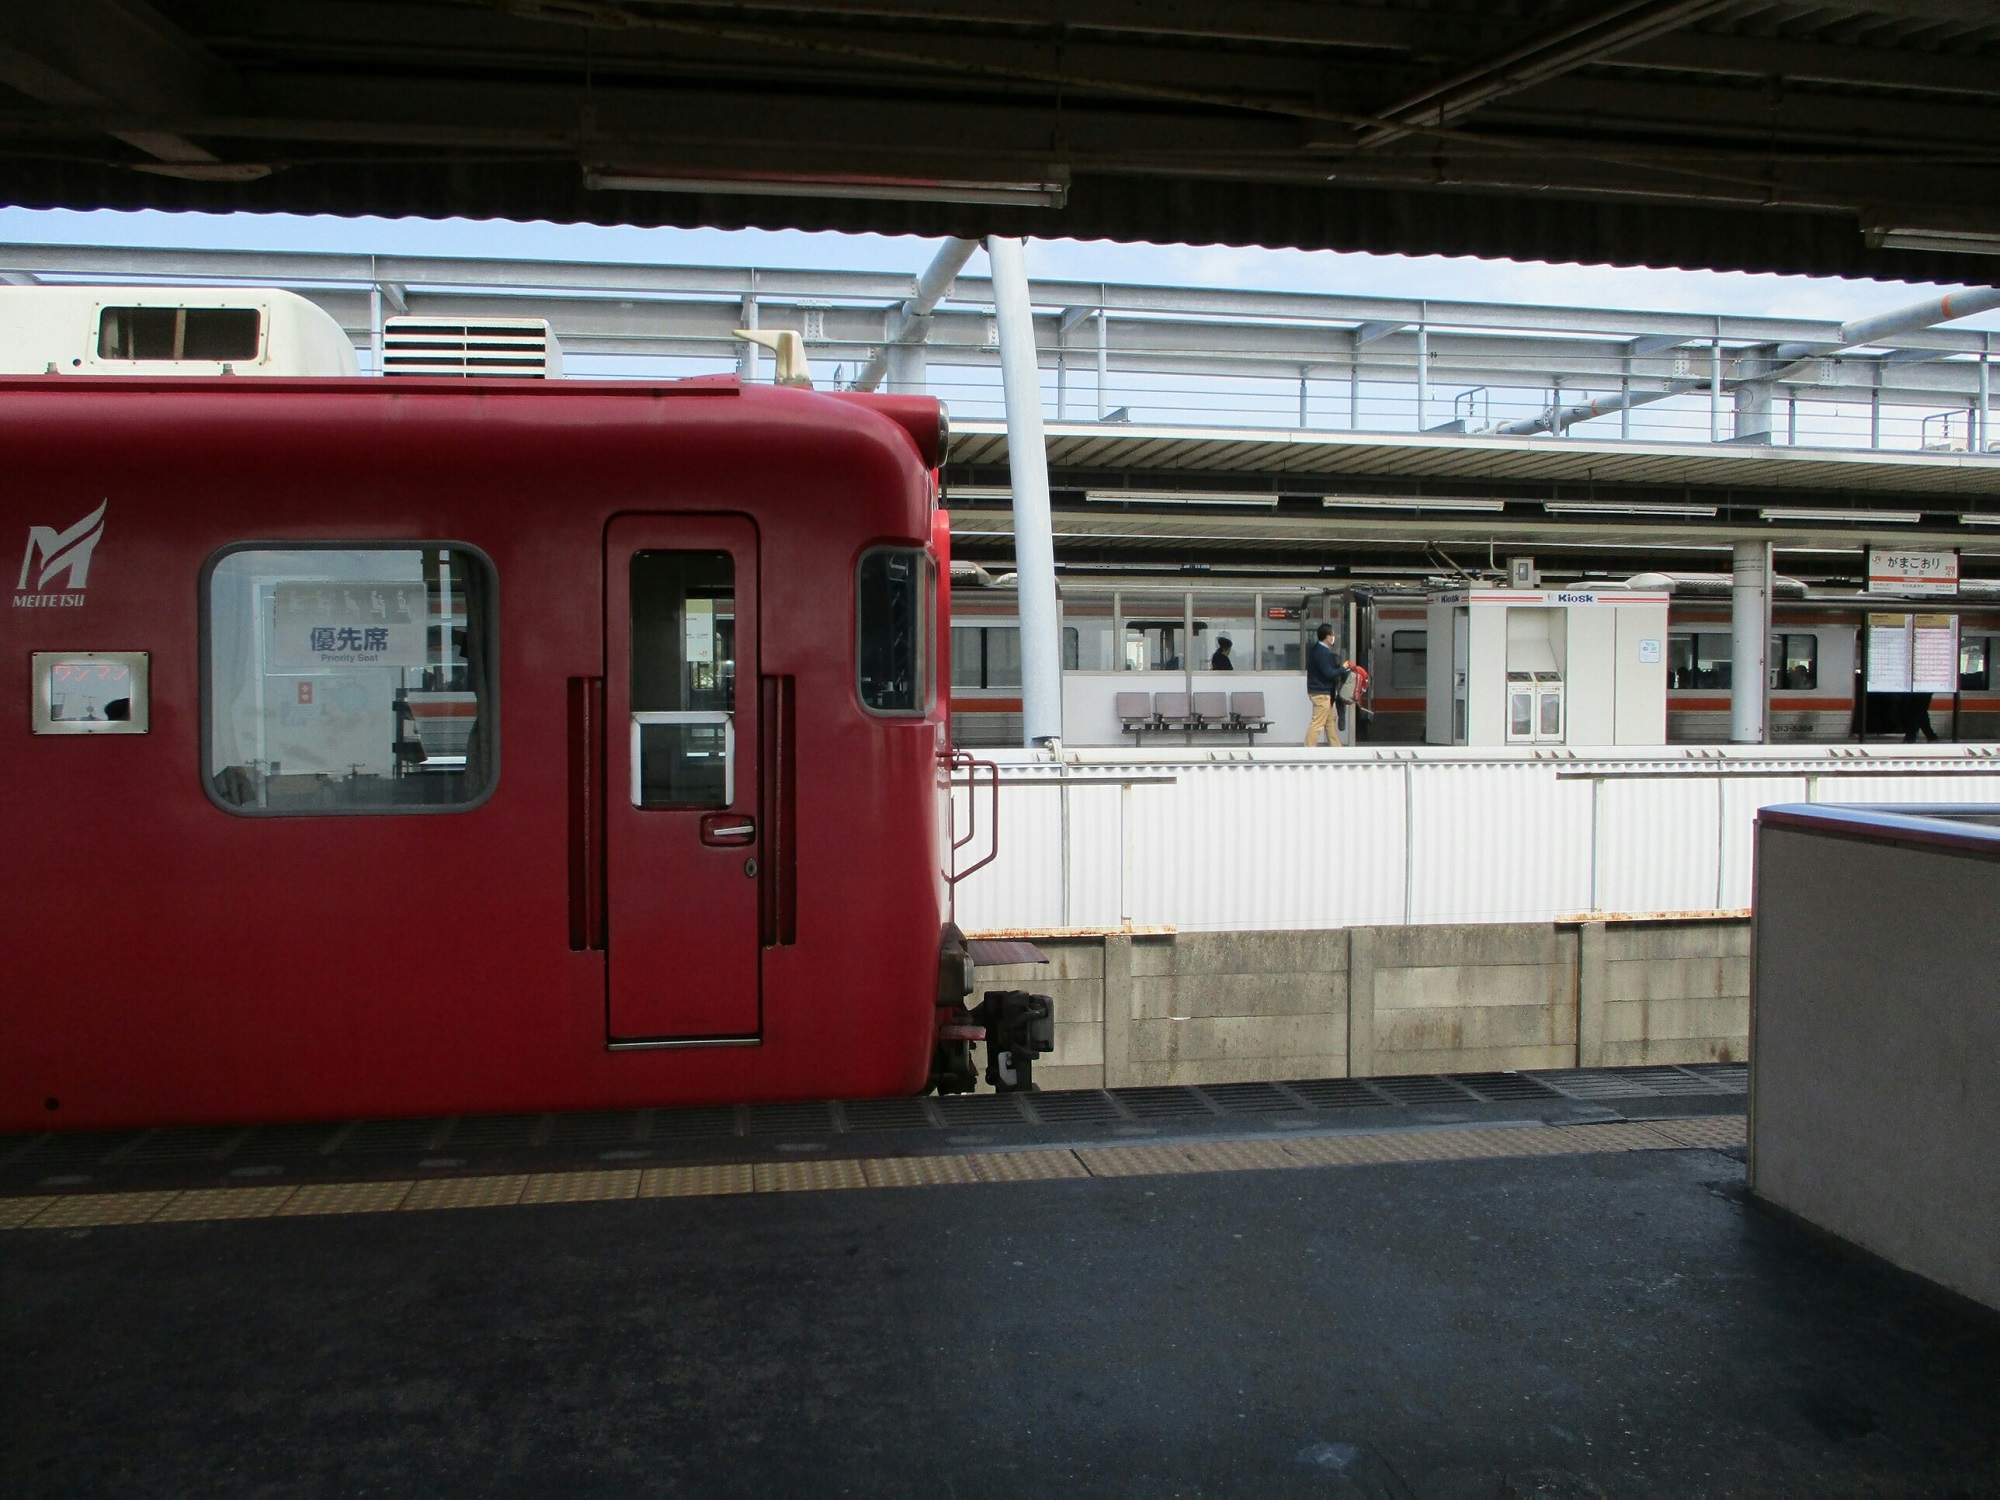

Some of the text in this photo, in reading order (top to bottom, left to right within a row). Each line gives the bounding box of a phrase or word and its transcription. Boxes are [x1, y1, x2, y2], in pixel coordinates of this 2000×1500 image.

[1887, 556, 1940, 570] がまごおり
[12, 594, 86, 608] MEITETSU
[310, 626, 389, 652] 優先席
[321, 653, 379, 664] Priority Seat
